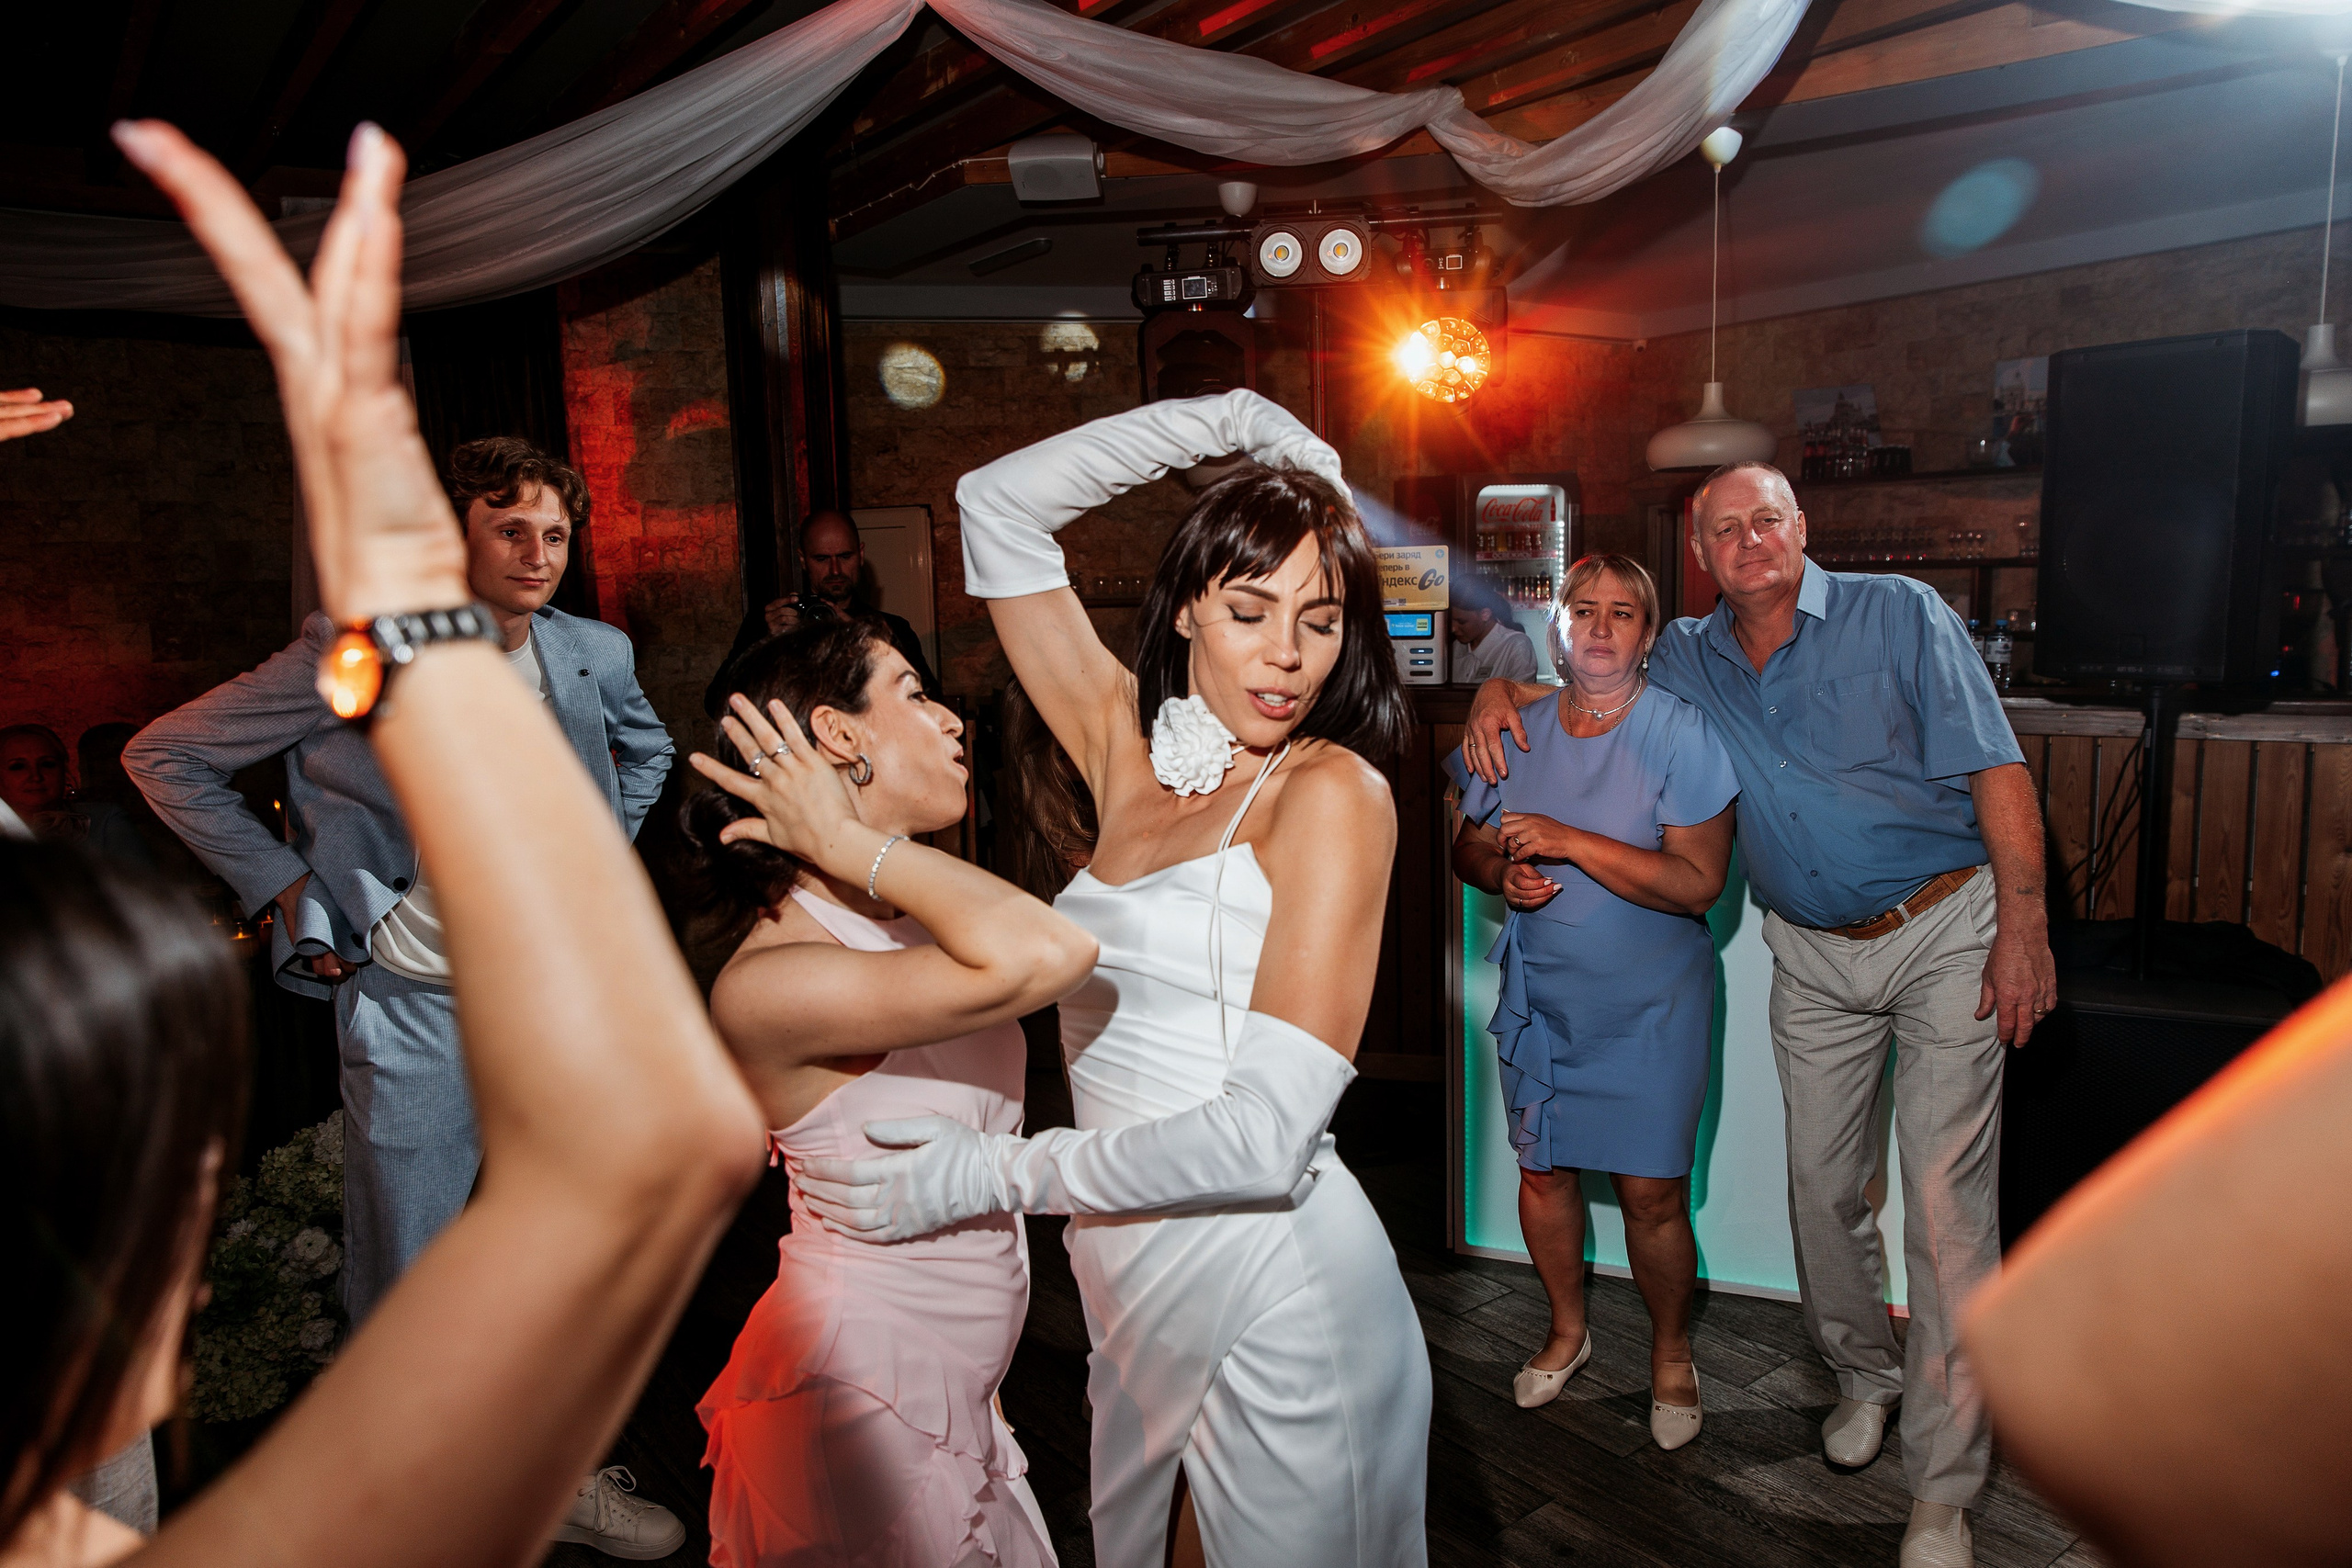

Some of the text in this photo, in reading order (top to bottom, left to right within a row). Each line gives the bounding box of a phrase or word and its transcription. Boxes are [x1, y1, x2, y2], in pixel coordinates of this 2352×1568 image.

[1396, 551, 1421, 560] заряд
[1378, 564, 1403, 572] еперь
[1380, 569, 1445, 591] ндекс Go
